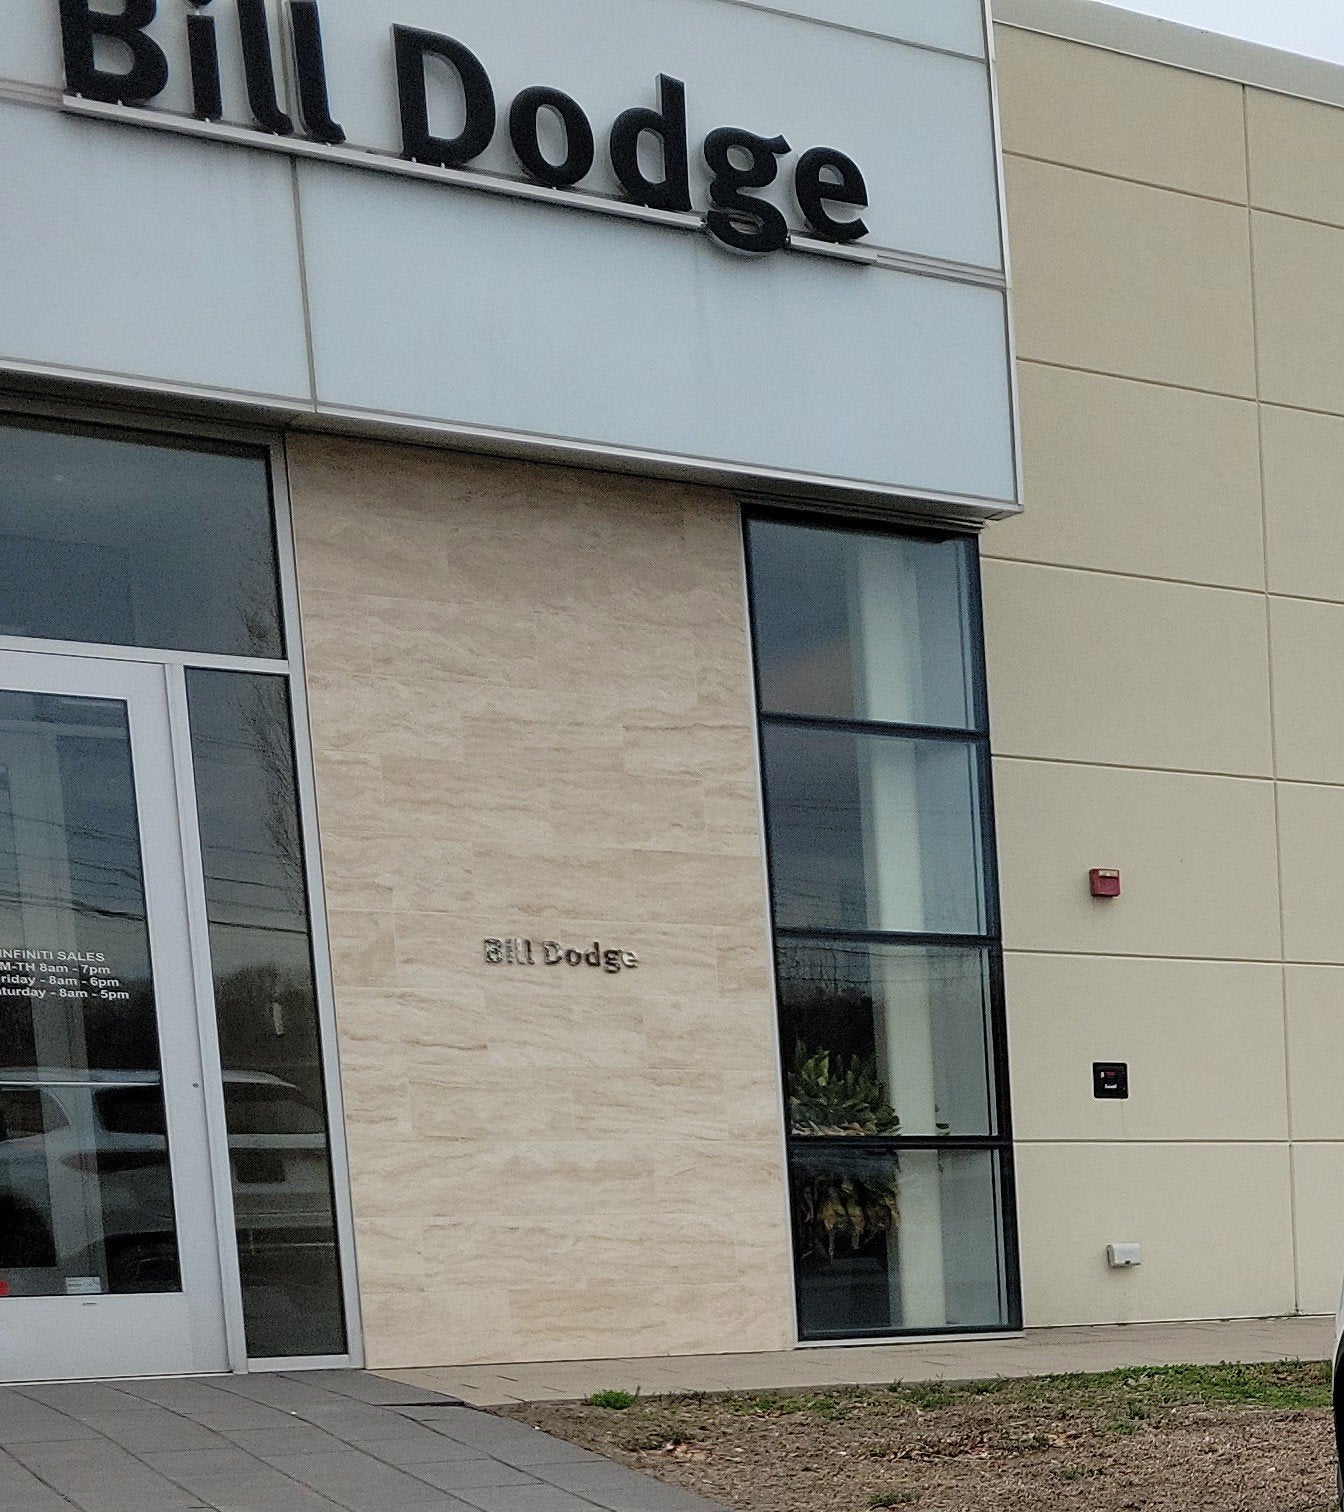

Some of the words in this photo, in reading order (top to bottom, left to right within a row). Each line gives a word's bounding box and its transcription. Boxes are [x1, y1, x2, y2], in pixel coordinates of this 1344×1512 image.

[60, 0, 347, 144] Bill
[392, 23, 870, 253] Dodge
[0, 949, 54, 960] INFINITI
[57, 951, 106, 962] SALES
[484, 938, 535, 966] Bill
[542, 941, 640, 974] Dodge
[0, 961, 36, 972] M-TH
[39, 963, 70, 973] 8am
[81, 964, 111, 975] 7pm
[0, 974, 37, 987] riday
[49, 976, 78, 986] 8am
[90, 977, 120, 988] 6pm
[0, 987, 47, 999] turday
[59, 989, 88, 998] 8am
[100, 990, 130, 1000] 5pm
